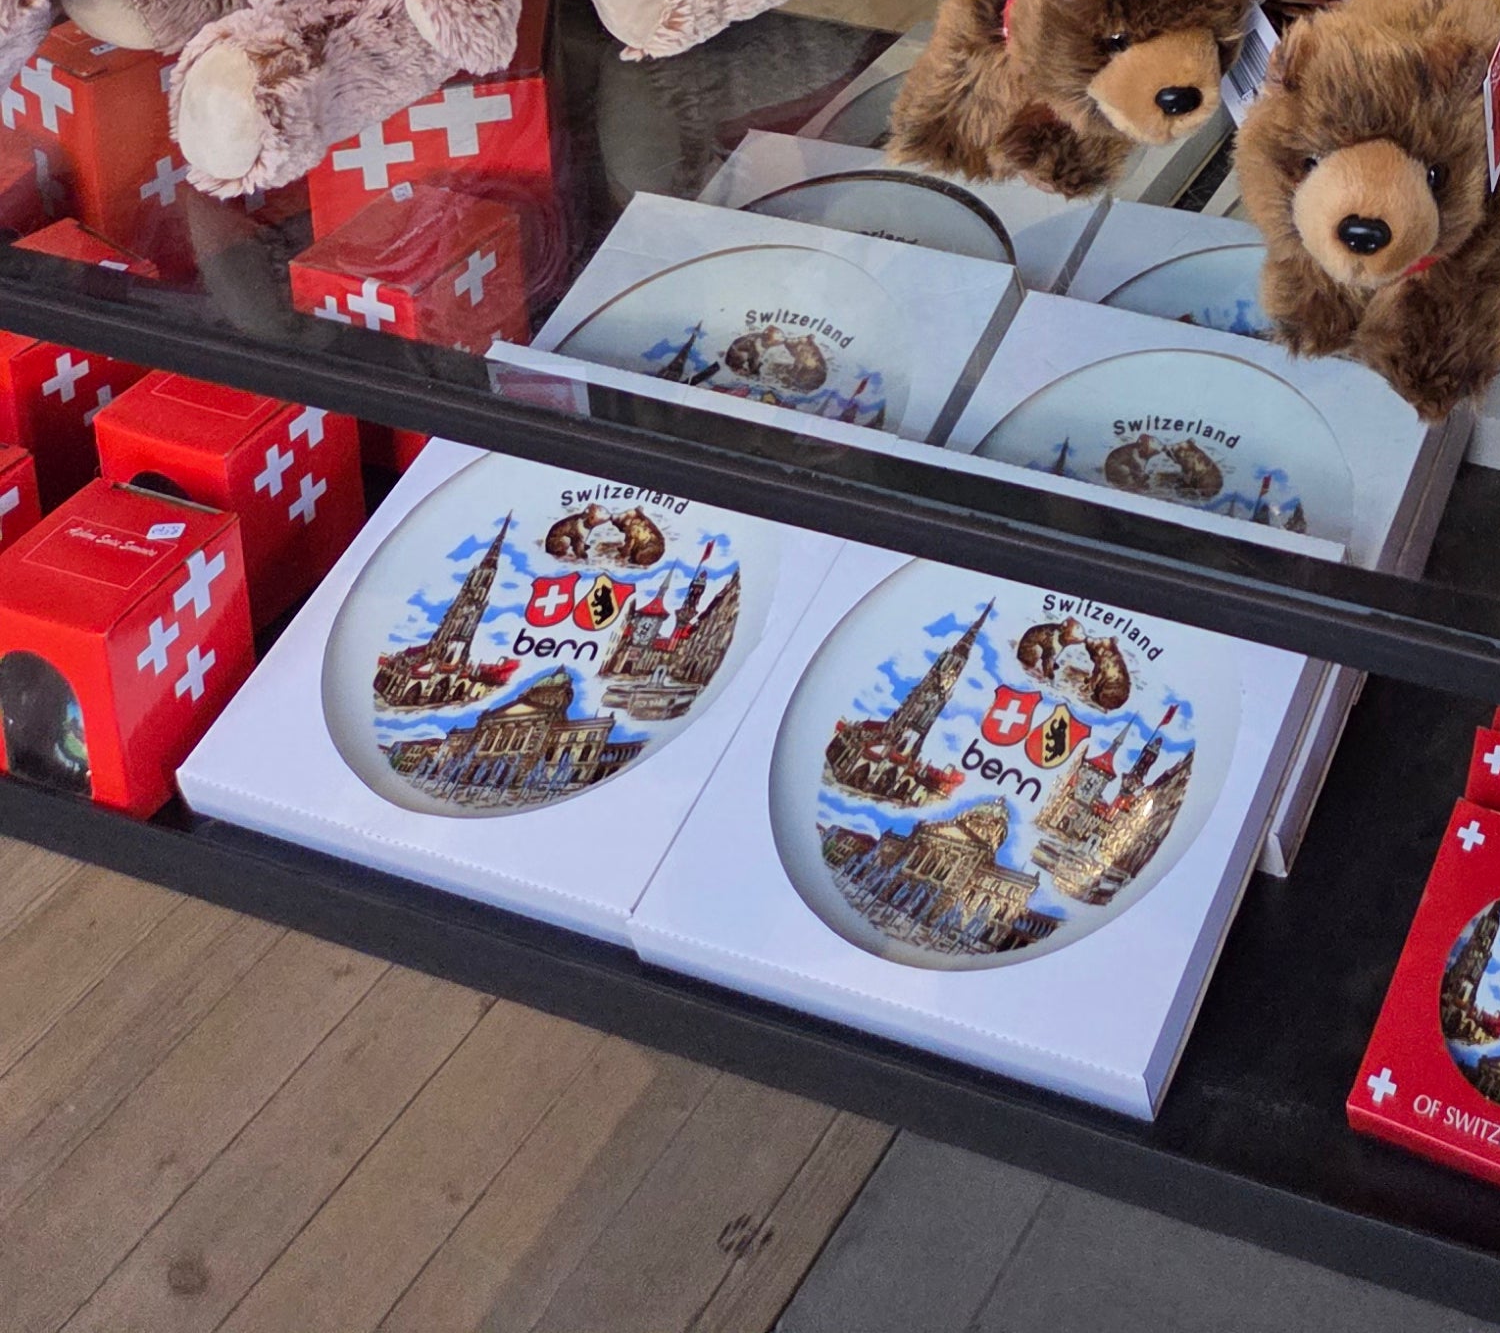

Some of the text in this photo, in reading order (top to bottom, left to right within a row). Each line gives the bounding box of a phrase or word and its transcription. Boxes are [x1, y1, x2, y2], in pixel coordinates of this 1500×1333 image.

[744, 307, 855, 350] Switzerland
[1111, 414, 1240, 451] Switzerland
[560, 482, 692, 517] Switzerland
[513, 626, 598, 663] bern
[1040, 591, 1165, 663] Switzerland
[960, 736, 1040, 803] bern
[1412, 1093, 1445, 1119] OF
